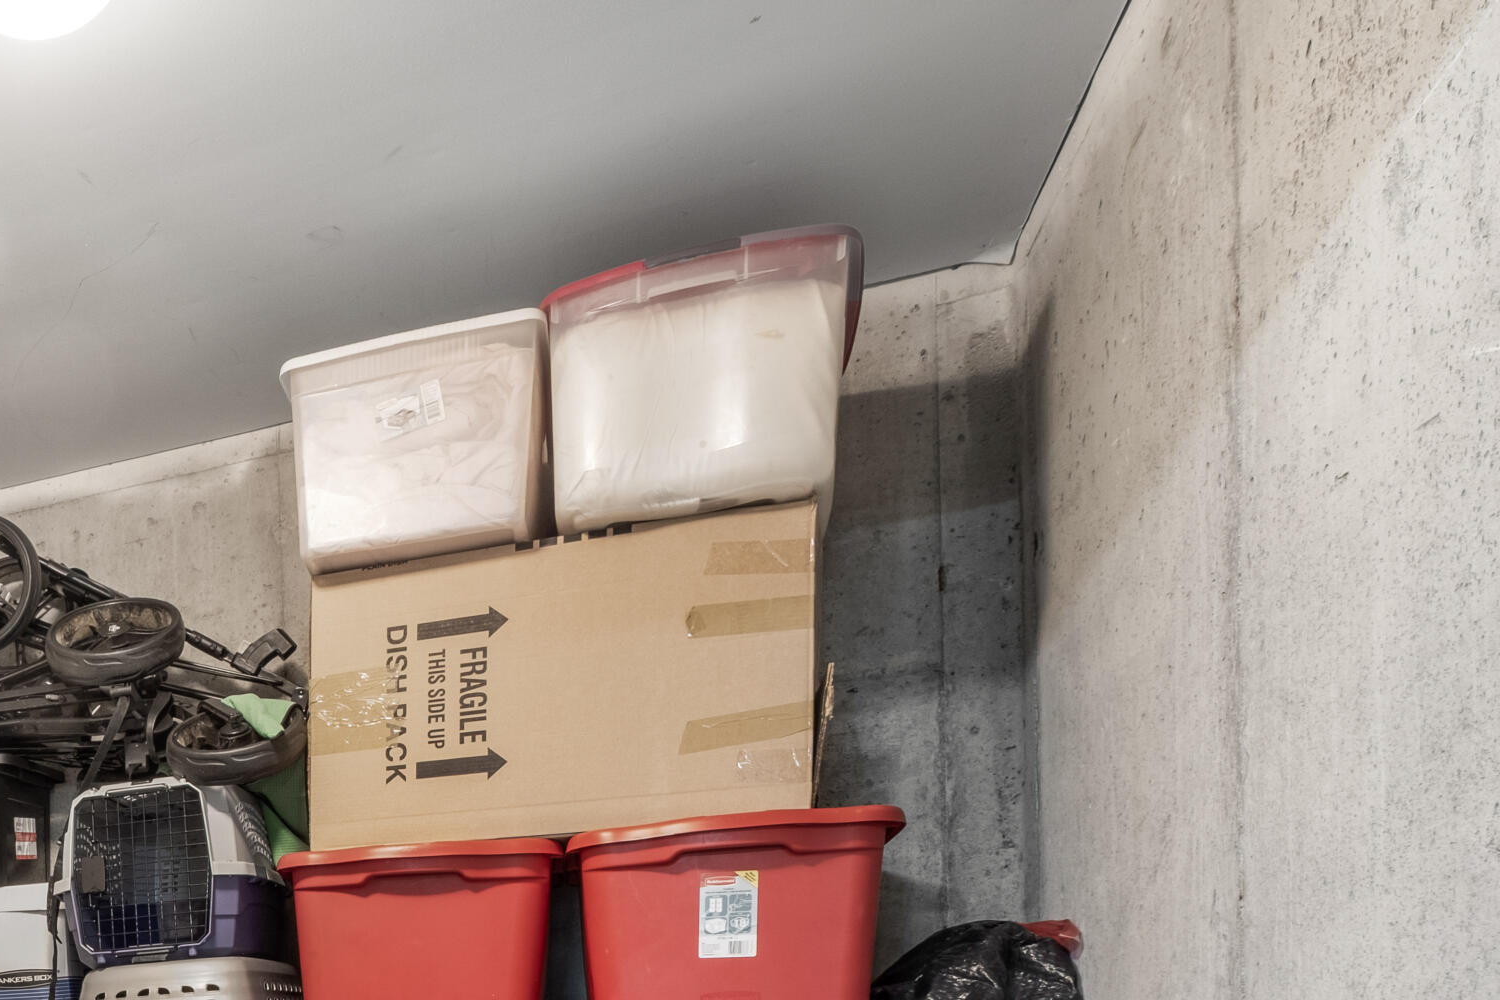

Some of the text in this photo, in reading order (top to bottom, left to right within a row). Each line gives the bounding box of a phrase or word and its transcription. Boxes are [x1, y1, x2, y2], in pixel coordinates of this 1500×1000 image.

[385, 624, 408, 784] DISH PACK
[427, 649, 446, 749] THIS SIDE UP
[459, 646, 487, 744] FRAGILE
[33, 974, 53, 982] BOX
